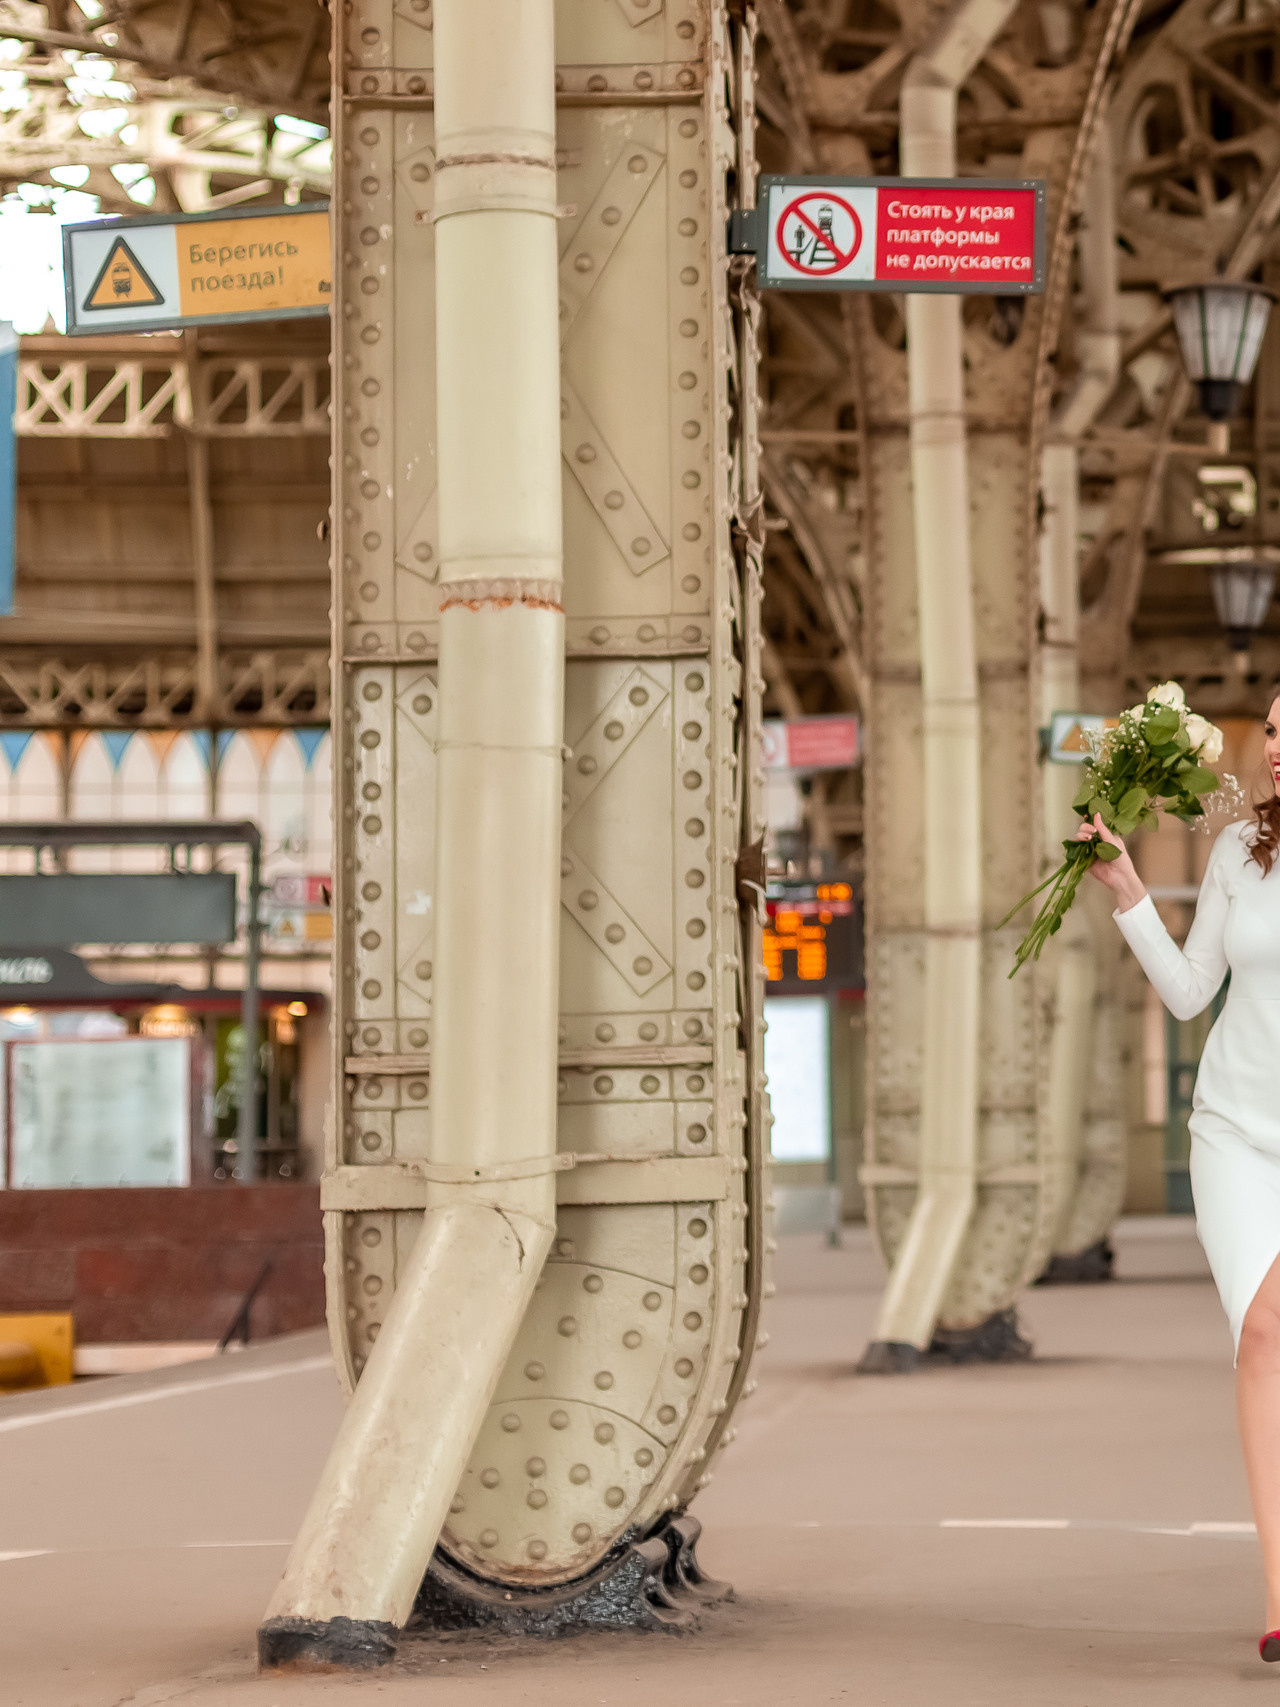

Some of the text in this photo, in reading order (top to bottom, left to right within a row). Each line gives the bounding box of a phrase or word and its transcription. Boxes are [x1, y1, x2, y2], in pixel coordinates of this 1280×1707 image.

[887, 201, 1014, 224] Стоять у края
[887, 227, 999, 247] платформы
[189, 240, 298, 267] Берегись
[886, 254, 1032, 273] не допускается
[190, 265, 284, 293] поезда!
